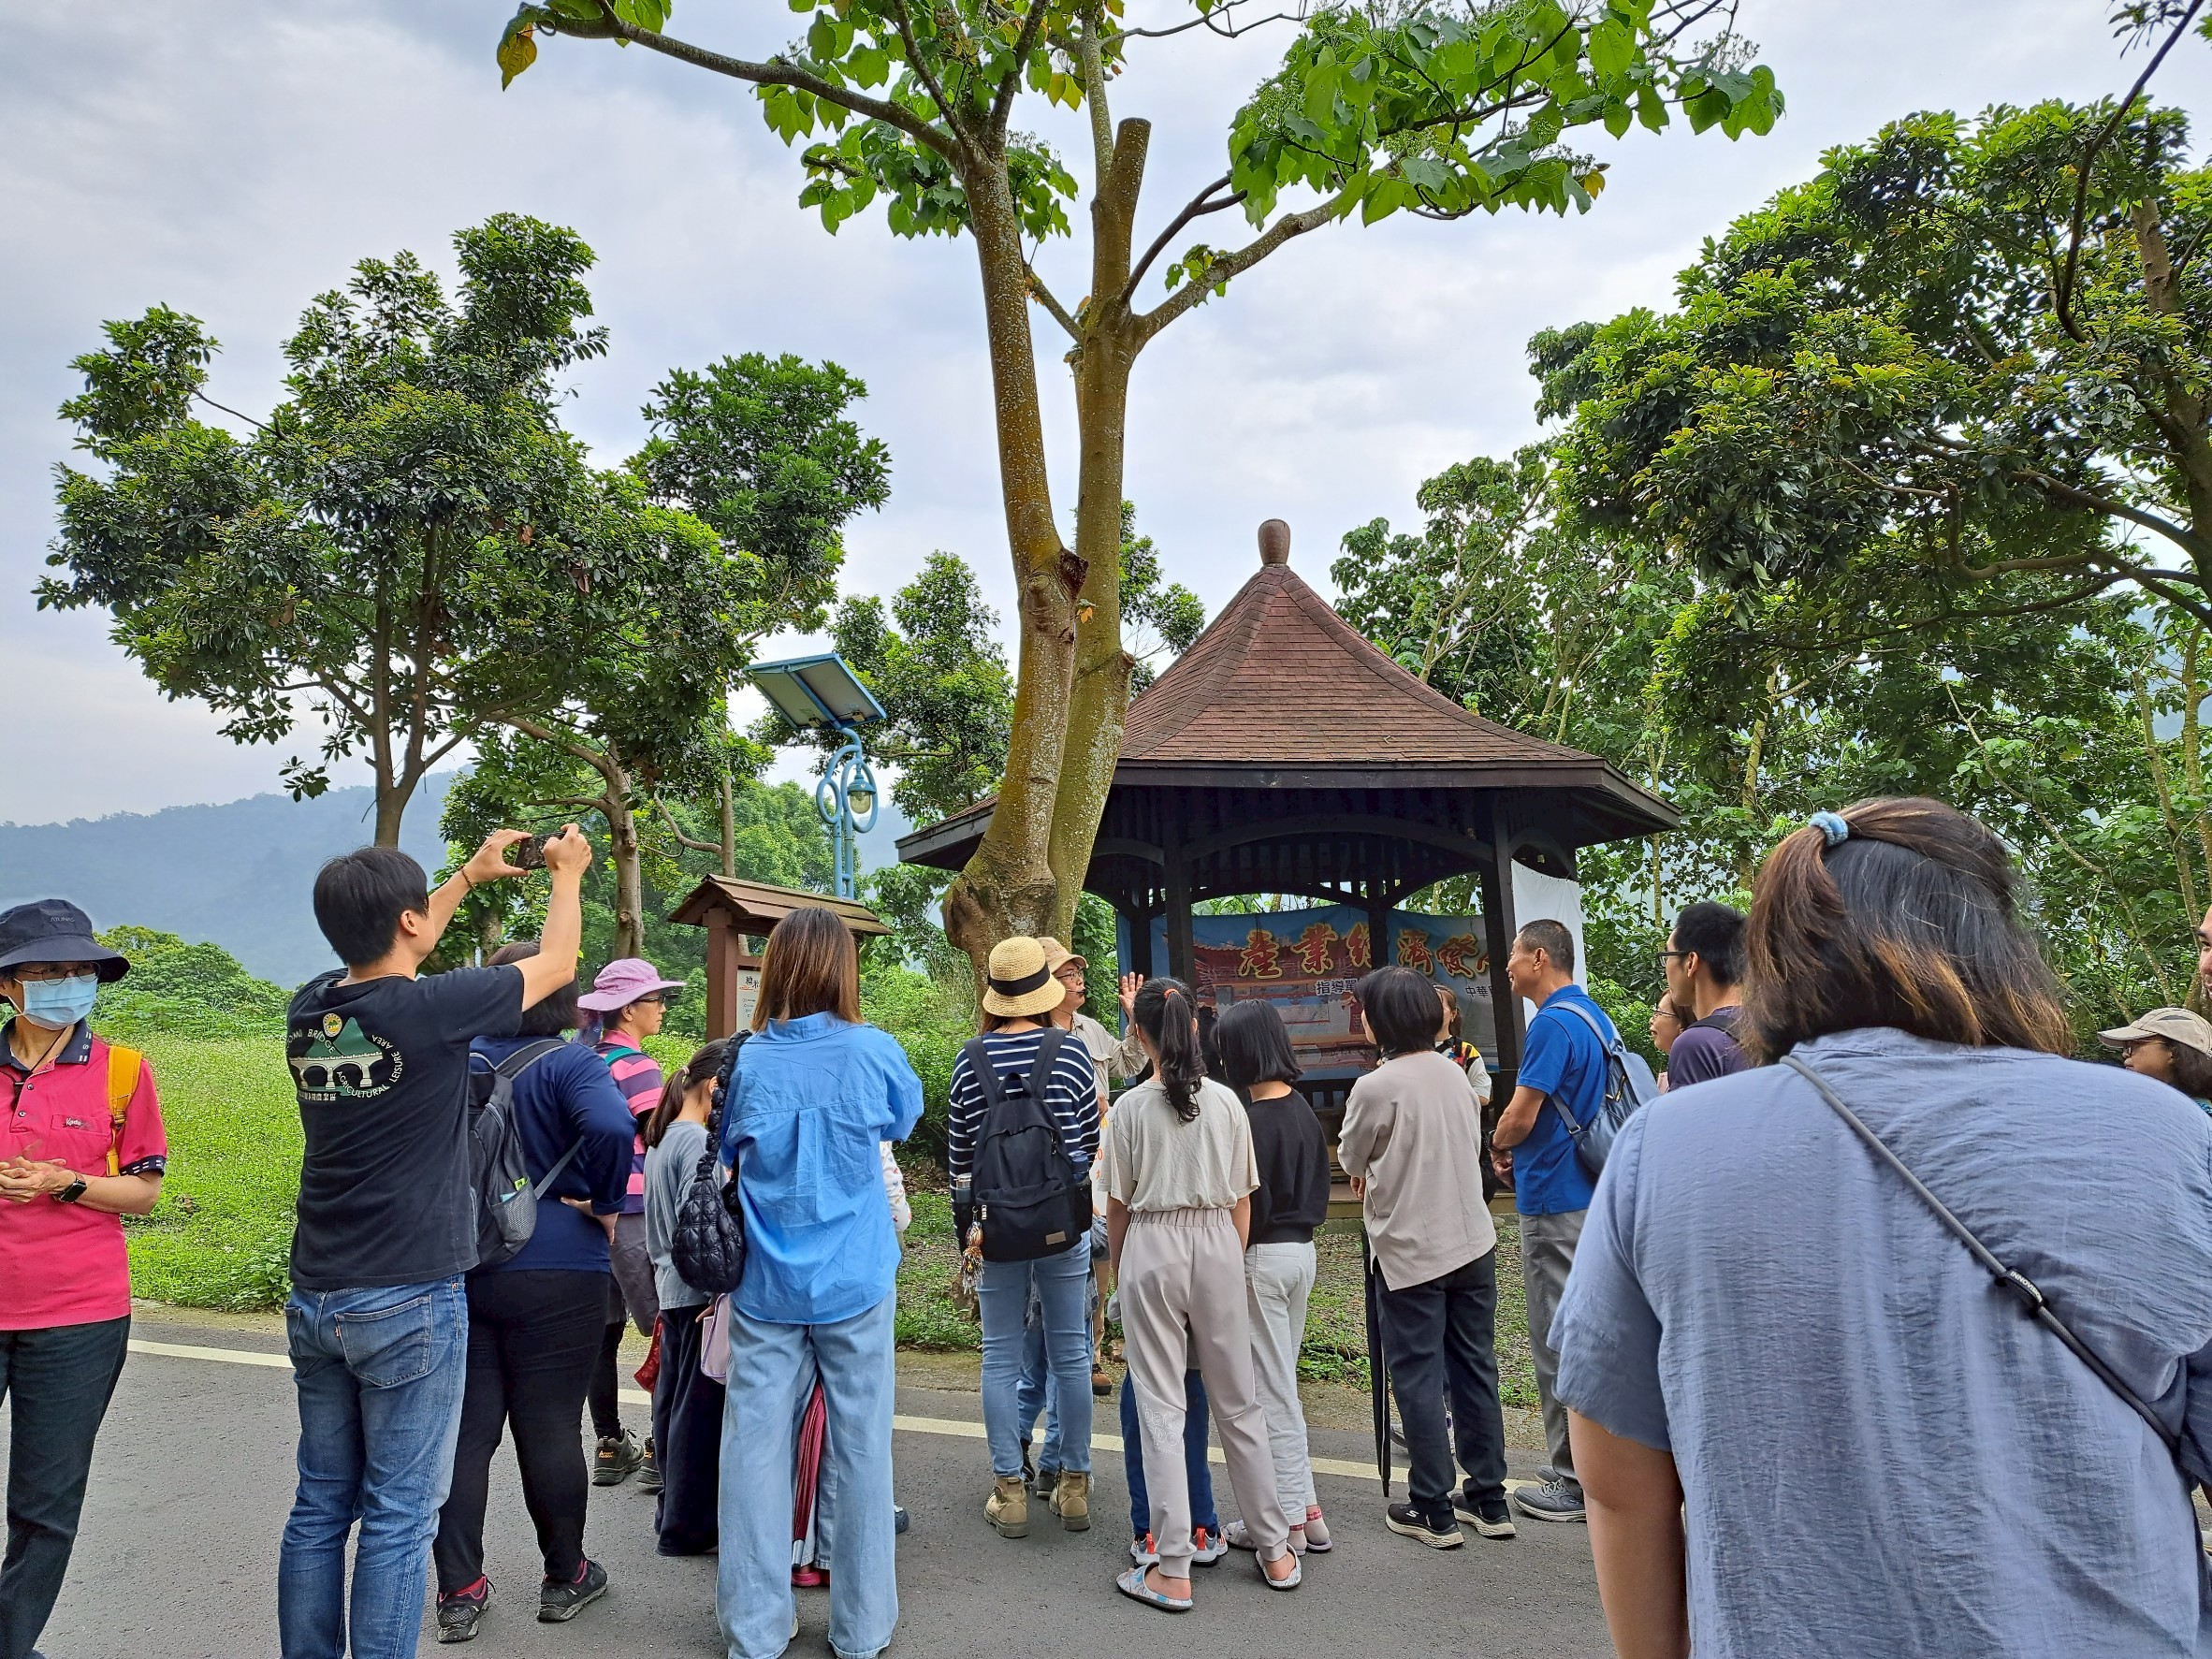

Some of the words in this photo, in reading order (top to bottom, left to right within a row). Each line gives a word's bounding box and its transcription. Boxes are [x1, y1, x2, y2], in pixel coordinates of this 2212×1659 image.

[1238, 923, 1490, 980] 產業經濟發
[1465, 985, 1492, 998] 中華
[307, 1028, 336, 1055] BRIDGE
[371, 1034, 394, 1049] AREA
[389, 1051, 403, 1083] LEISURE
[337, 1071, 391, 1099] AGRICULTURAL
